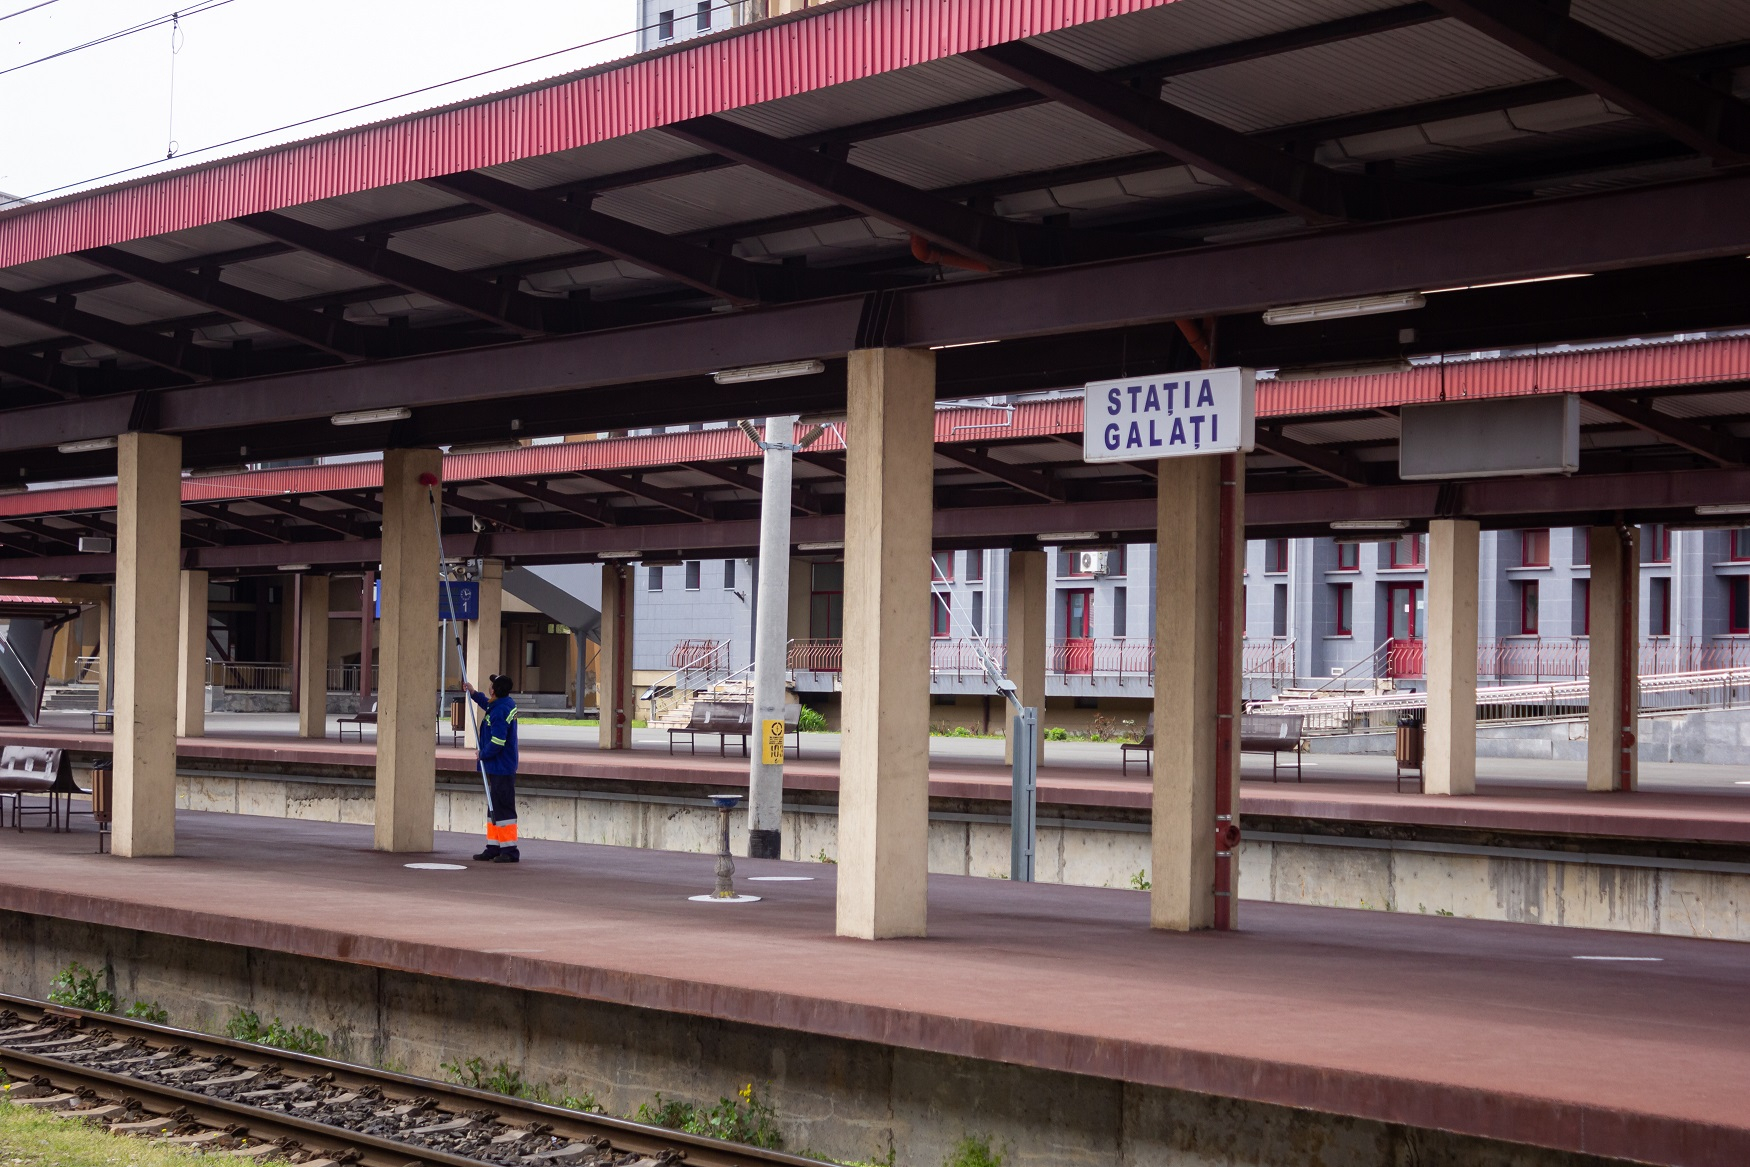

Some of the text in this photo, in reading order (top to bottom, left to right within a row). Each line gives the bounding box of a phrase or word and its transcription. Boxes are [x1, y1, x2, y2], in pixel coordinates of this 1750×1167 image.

[1107, 379, 1214, 416] STAȚIA
[1104, 413, 1218, 451] GALAȚI
[462, 601, 468, 613] 1
